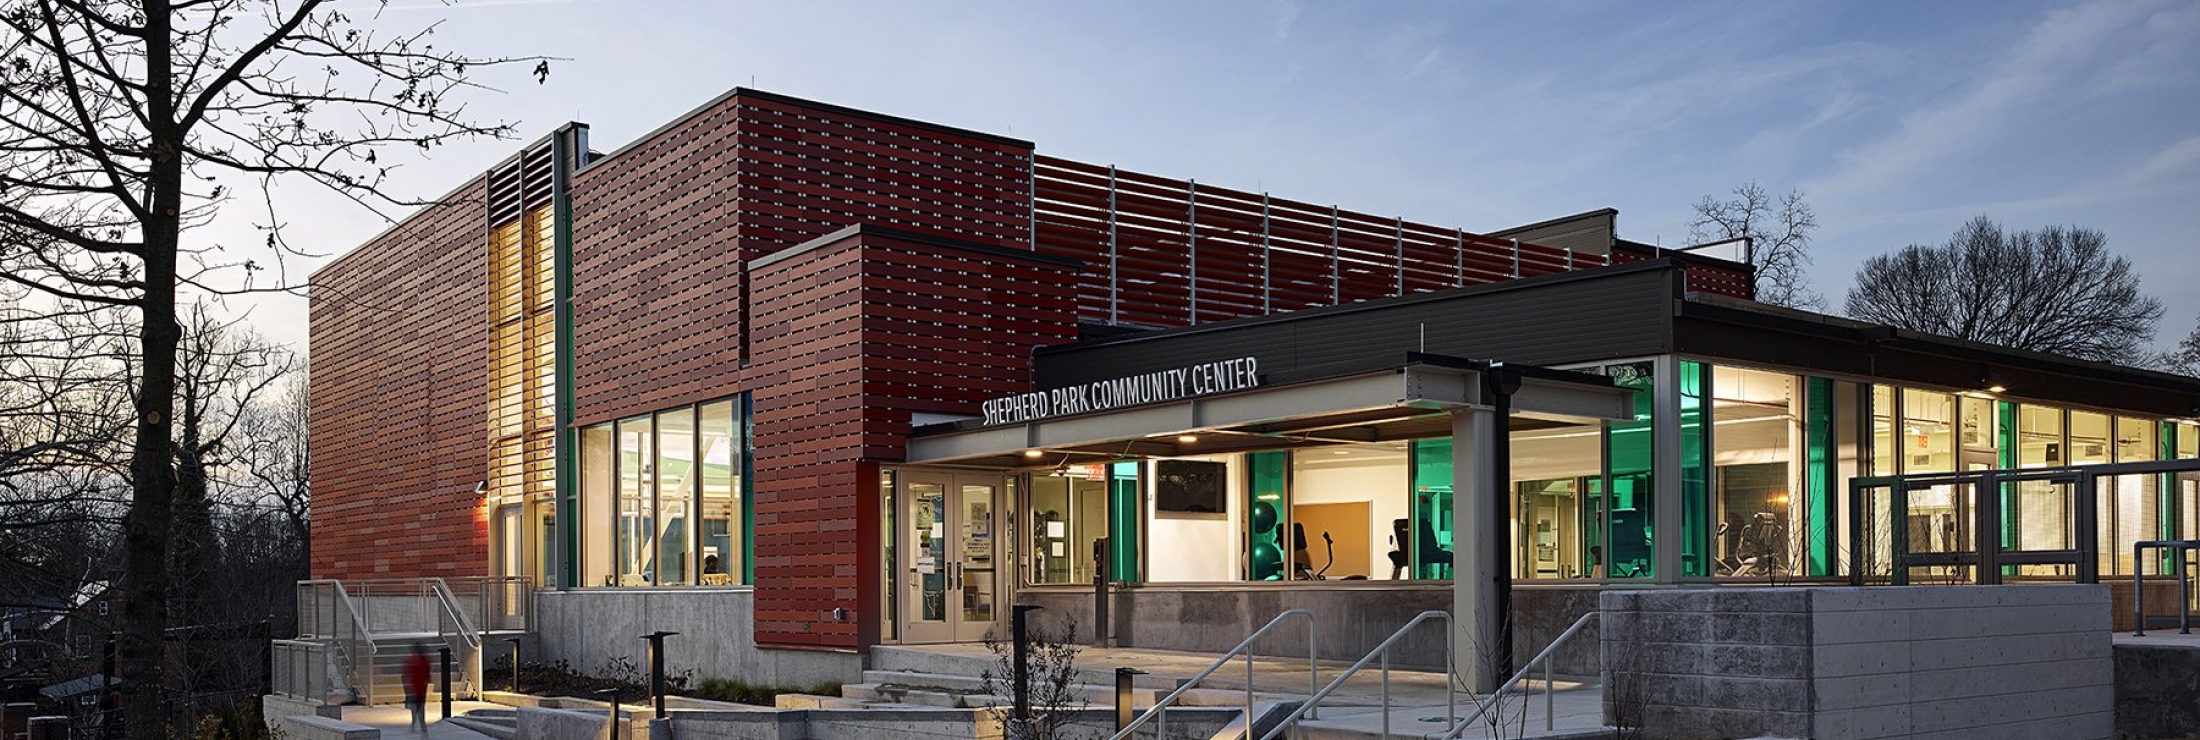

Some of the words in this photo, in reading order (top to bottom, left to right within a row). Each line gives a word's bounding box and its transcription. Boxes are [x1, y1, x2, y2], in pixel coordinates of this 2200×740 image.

[982, 392, 1048, 426] SHEPHERD
[1052, 384, 1090, 416] PARK
[1092, 368, 1188, 410] COMMUNITY
[1192, 356, 1259, 395] CENTER
